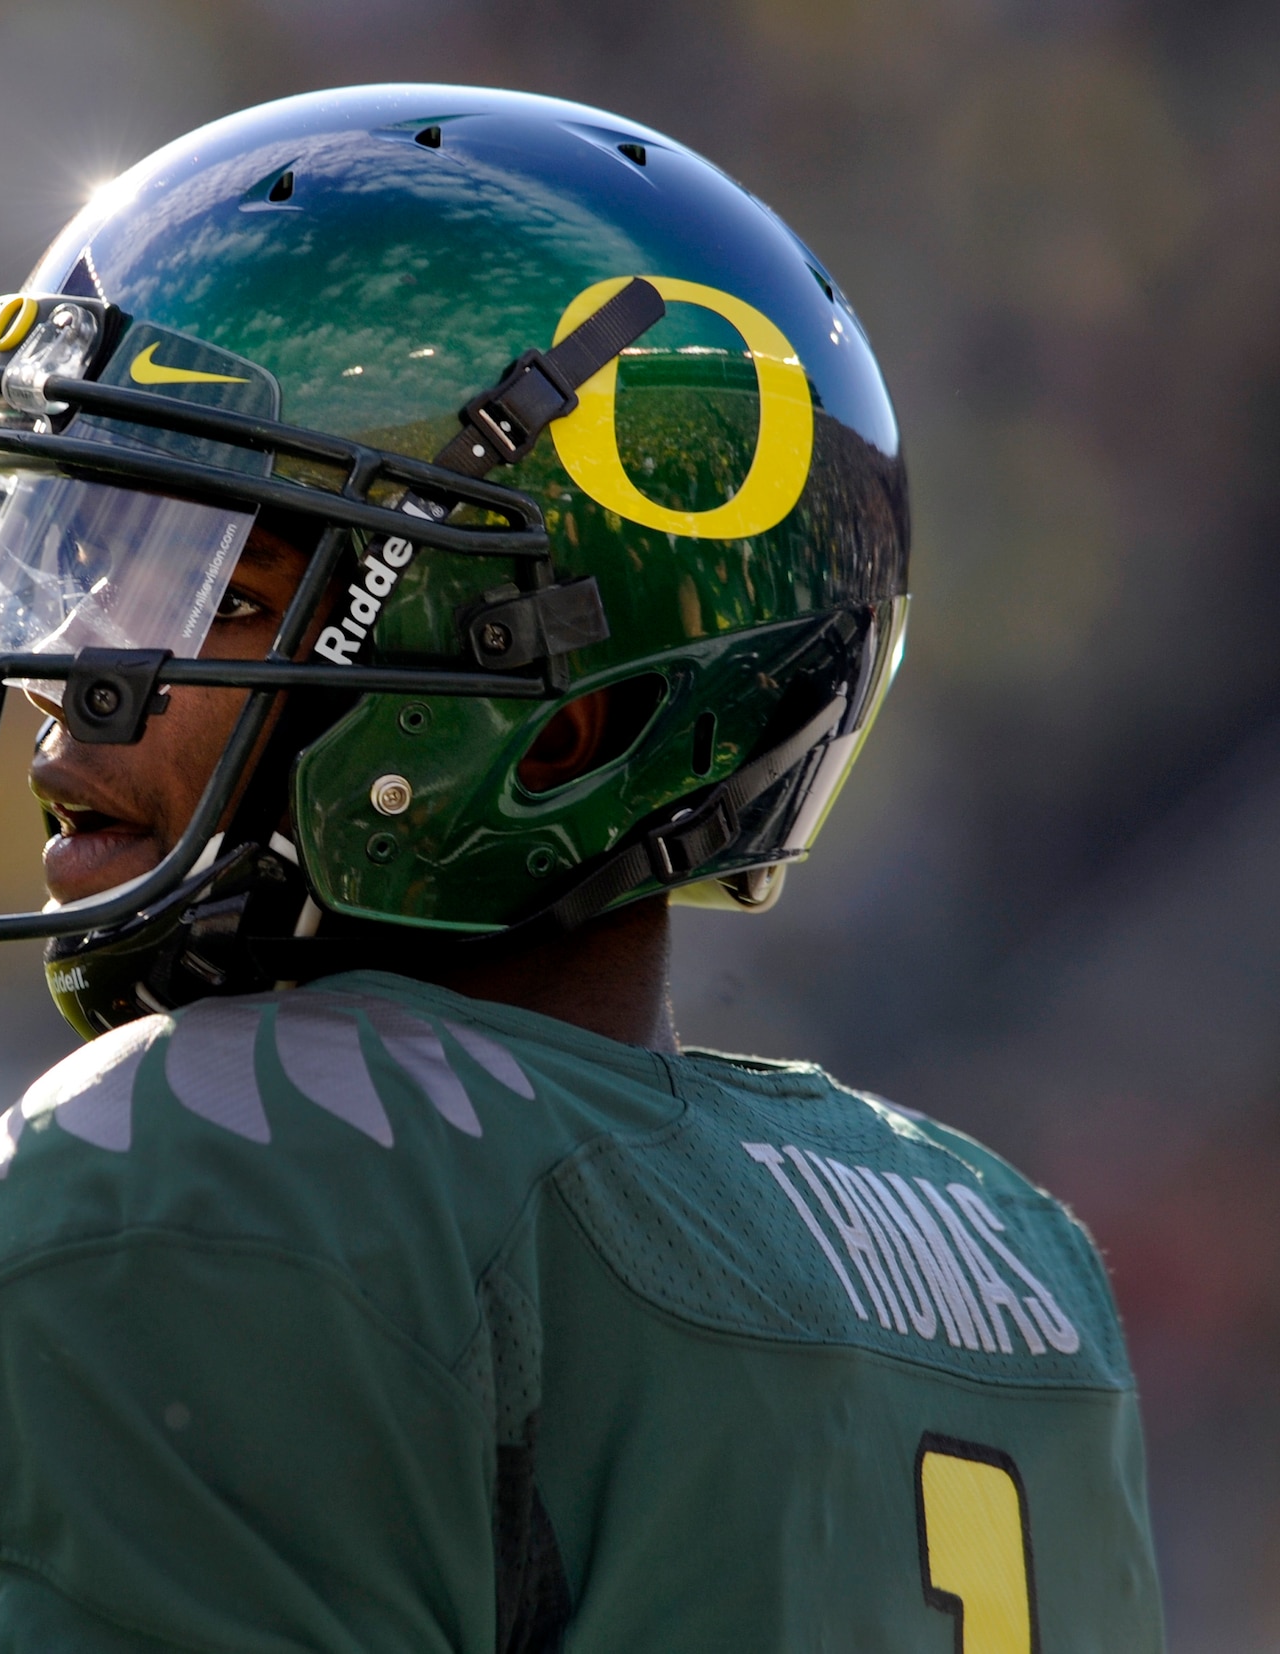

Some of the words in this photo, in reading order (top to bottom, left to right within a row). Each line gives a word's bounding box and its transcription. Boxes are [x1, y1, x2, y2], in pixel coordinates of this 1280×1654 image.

[549, 275, 814, 540] O
[740, 1141, 1081, 1355] THOMAS
[914, 1429, 1042, 1654] 1
